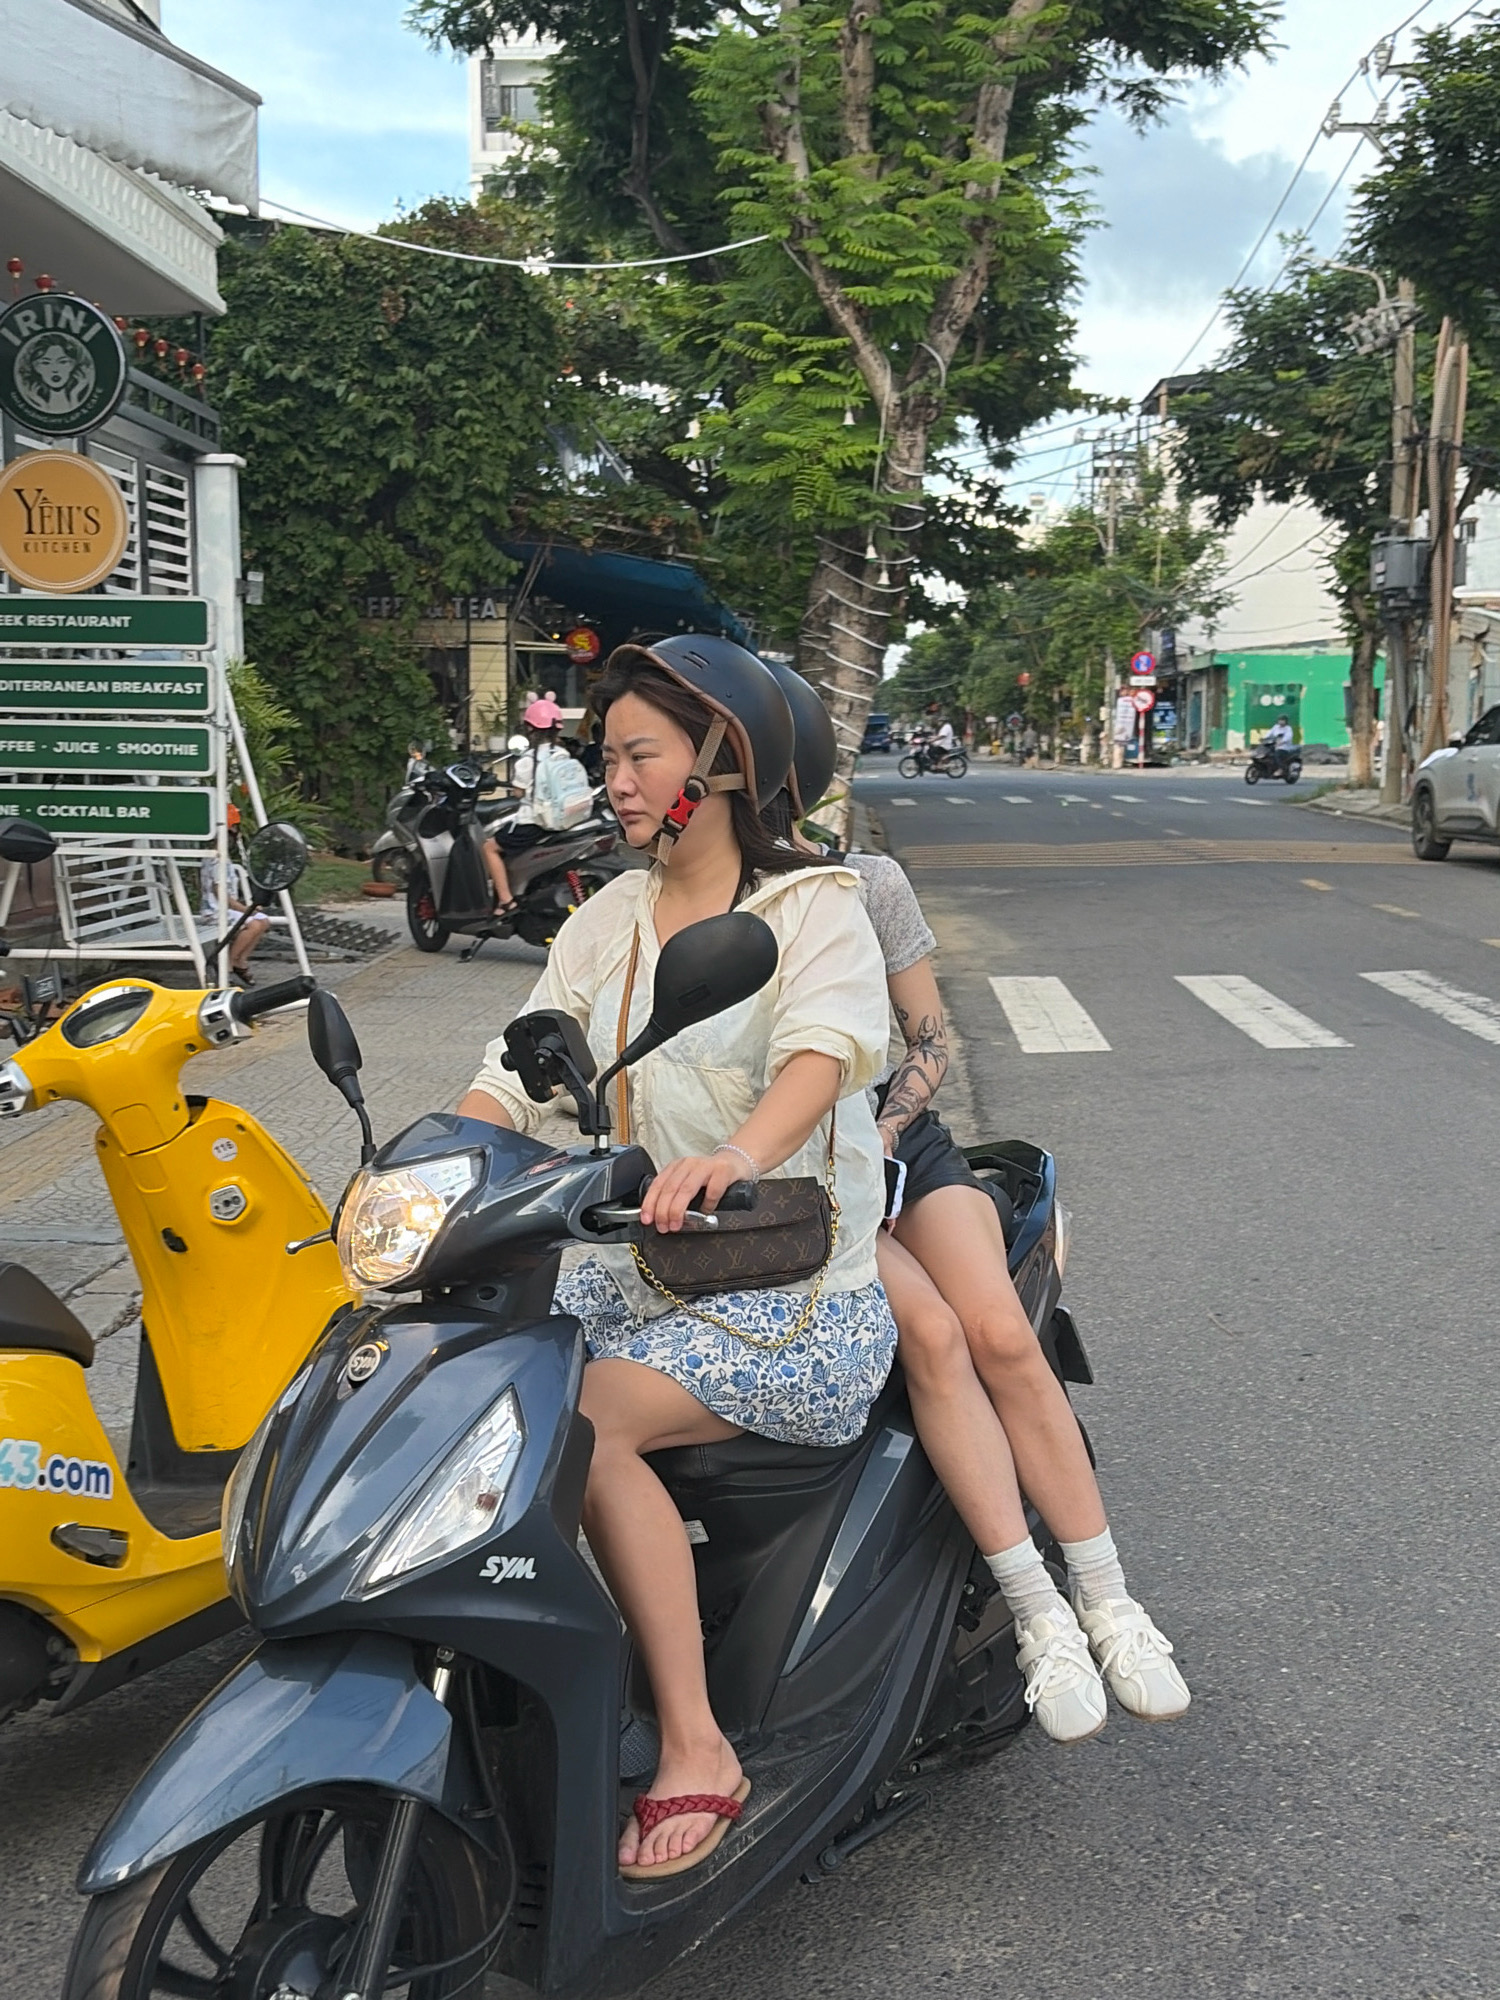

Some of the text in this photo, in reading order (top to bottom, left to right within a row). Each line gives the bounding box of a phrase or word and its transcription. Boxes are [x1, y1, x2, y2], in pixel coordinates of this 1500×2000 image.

[0, 304, 103, 346] IRINI
[23, 542, 91, 553] KITCHEN
[452, 598, 497, 619] TEA
[27, 616, 132, 628] RESTAURANT
[111, 682, 204, 694] BREAKFAST
[53, 742, 99, 754] JUICE
[117, 743, 199, 756] SMOOTHIE
[37, 805, 114, 818] COCKTAIL
[116, 807, 151, 818] BAR
[479, 1555, 537, 1584] SYM
